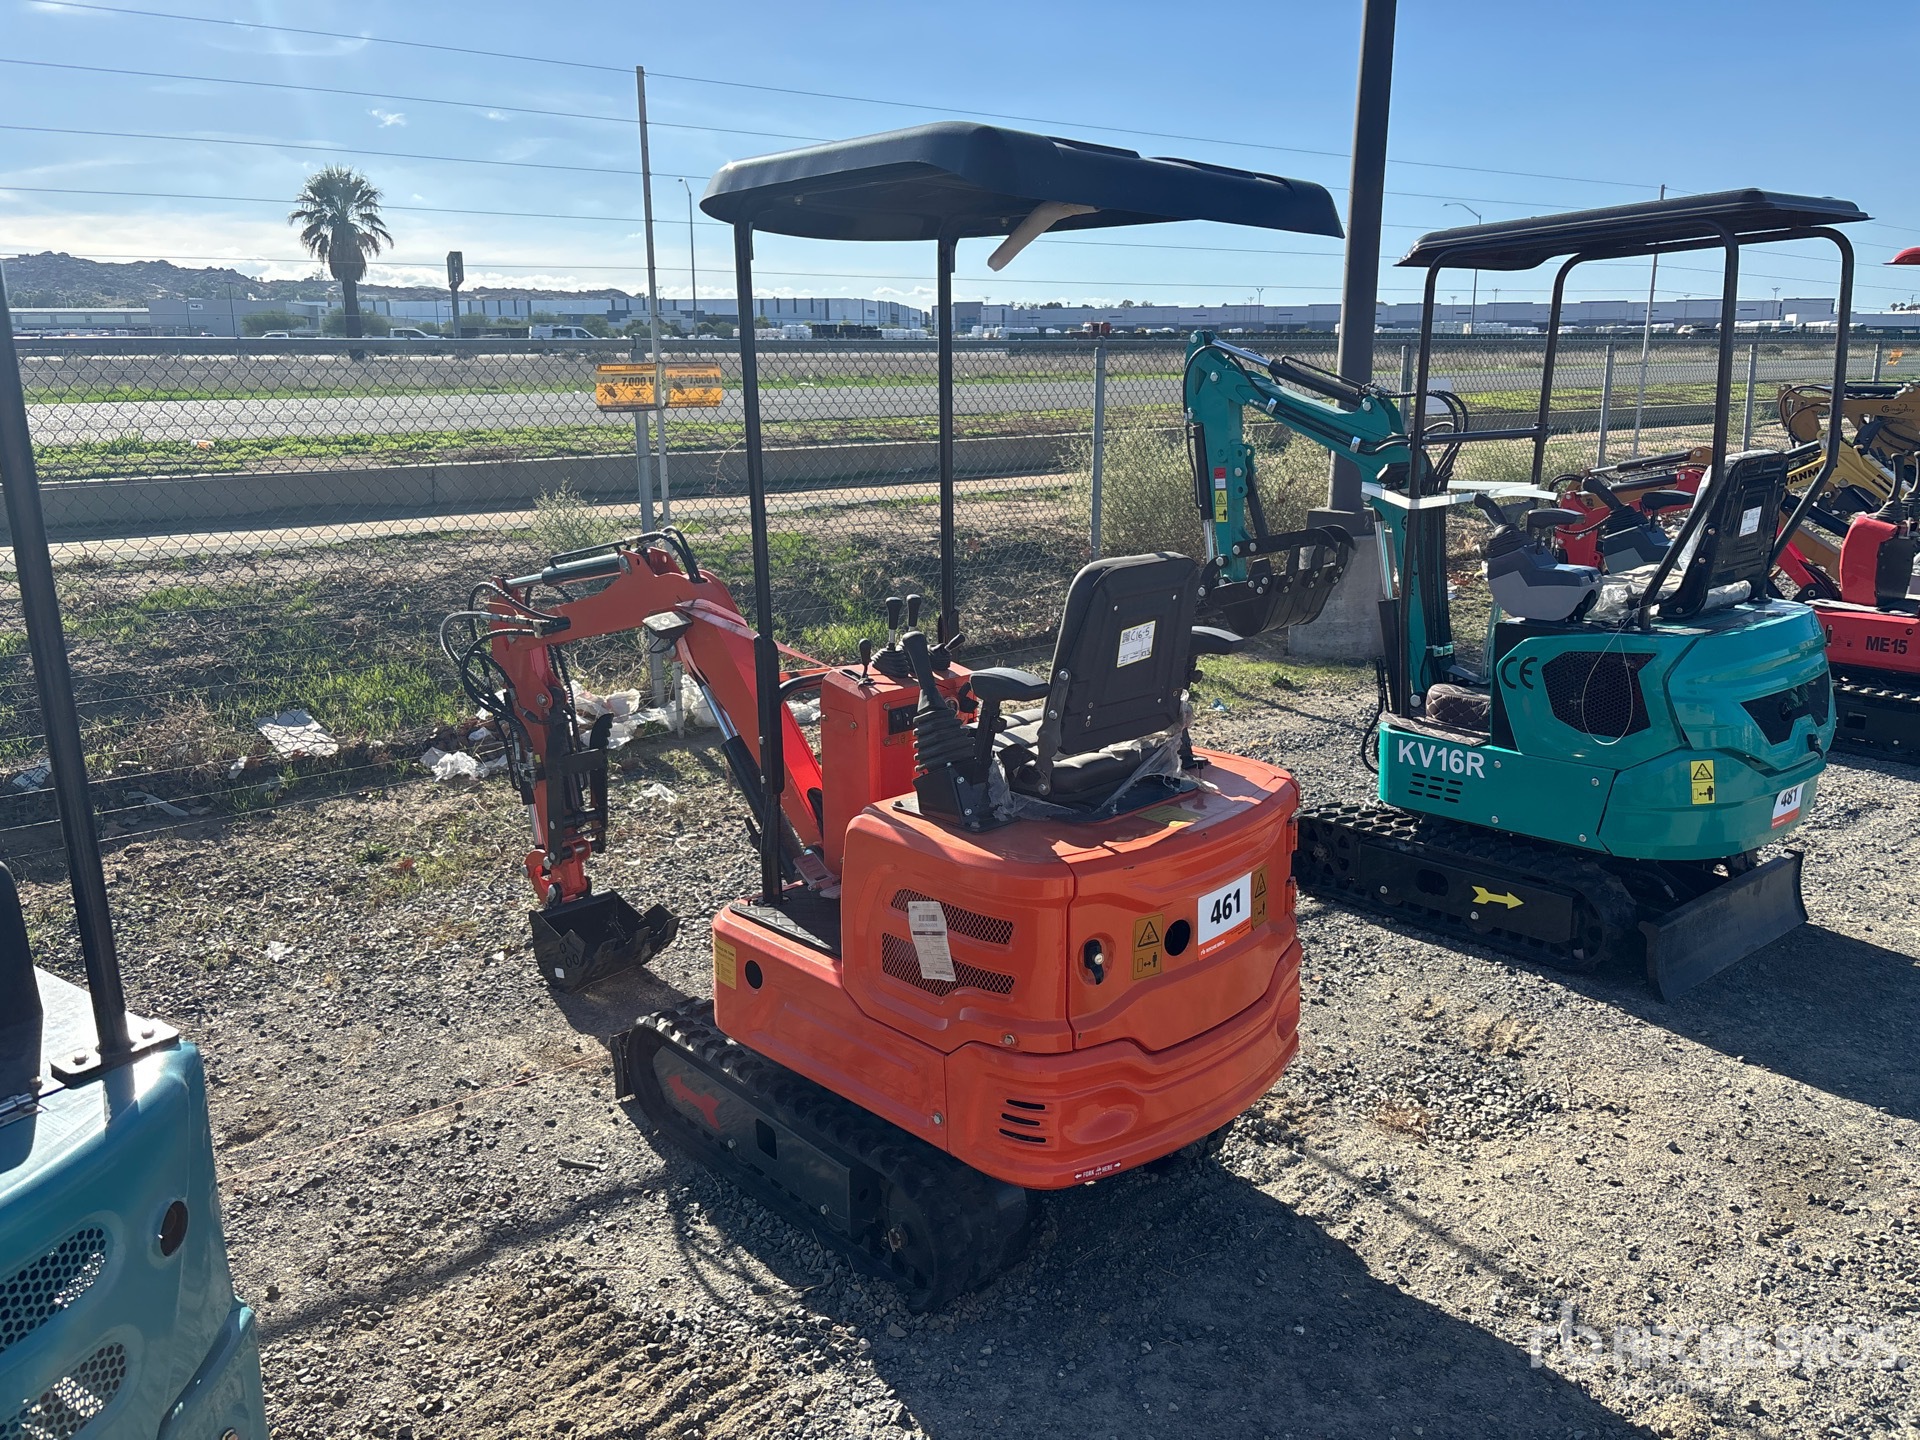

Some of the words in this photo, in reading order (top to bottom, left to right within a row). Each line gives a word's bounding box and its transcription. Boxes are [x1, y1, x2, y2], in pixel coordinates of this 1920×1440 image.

[622, 376, 646, 387] 7,000
[1865, 635, 1908, 655] ME15
[1500, 656, 1538, 690] CE
[1398, 739, 1486, 779] KV16R
[1780, 786, 1799, 807] 481
[1210, 887, 1241, 925] 461
